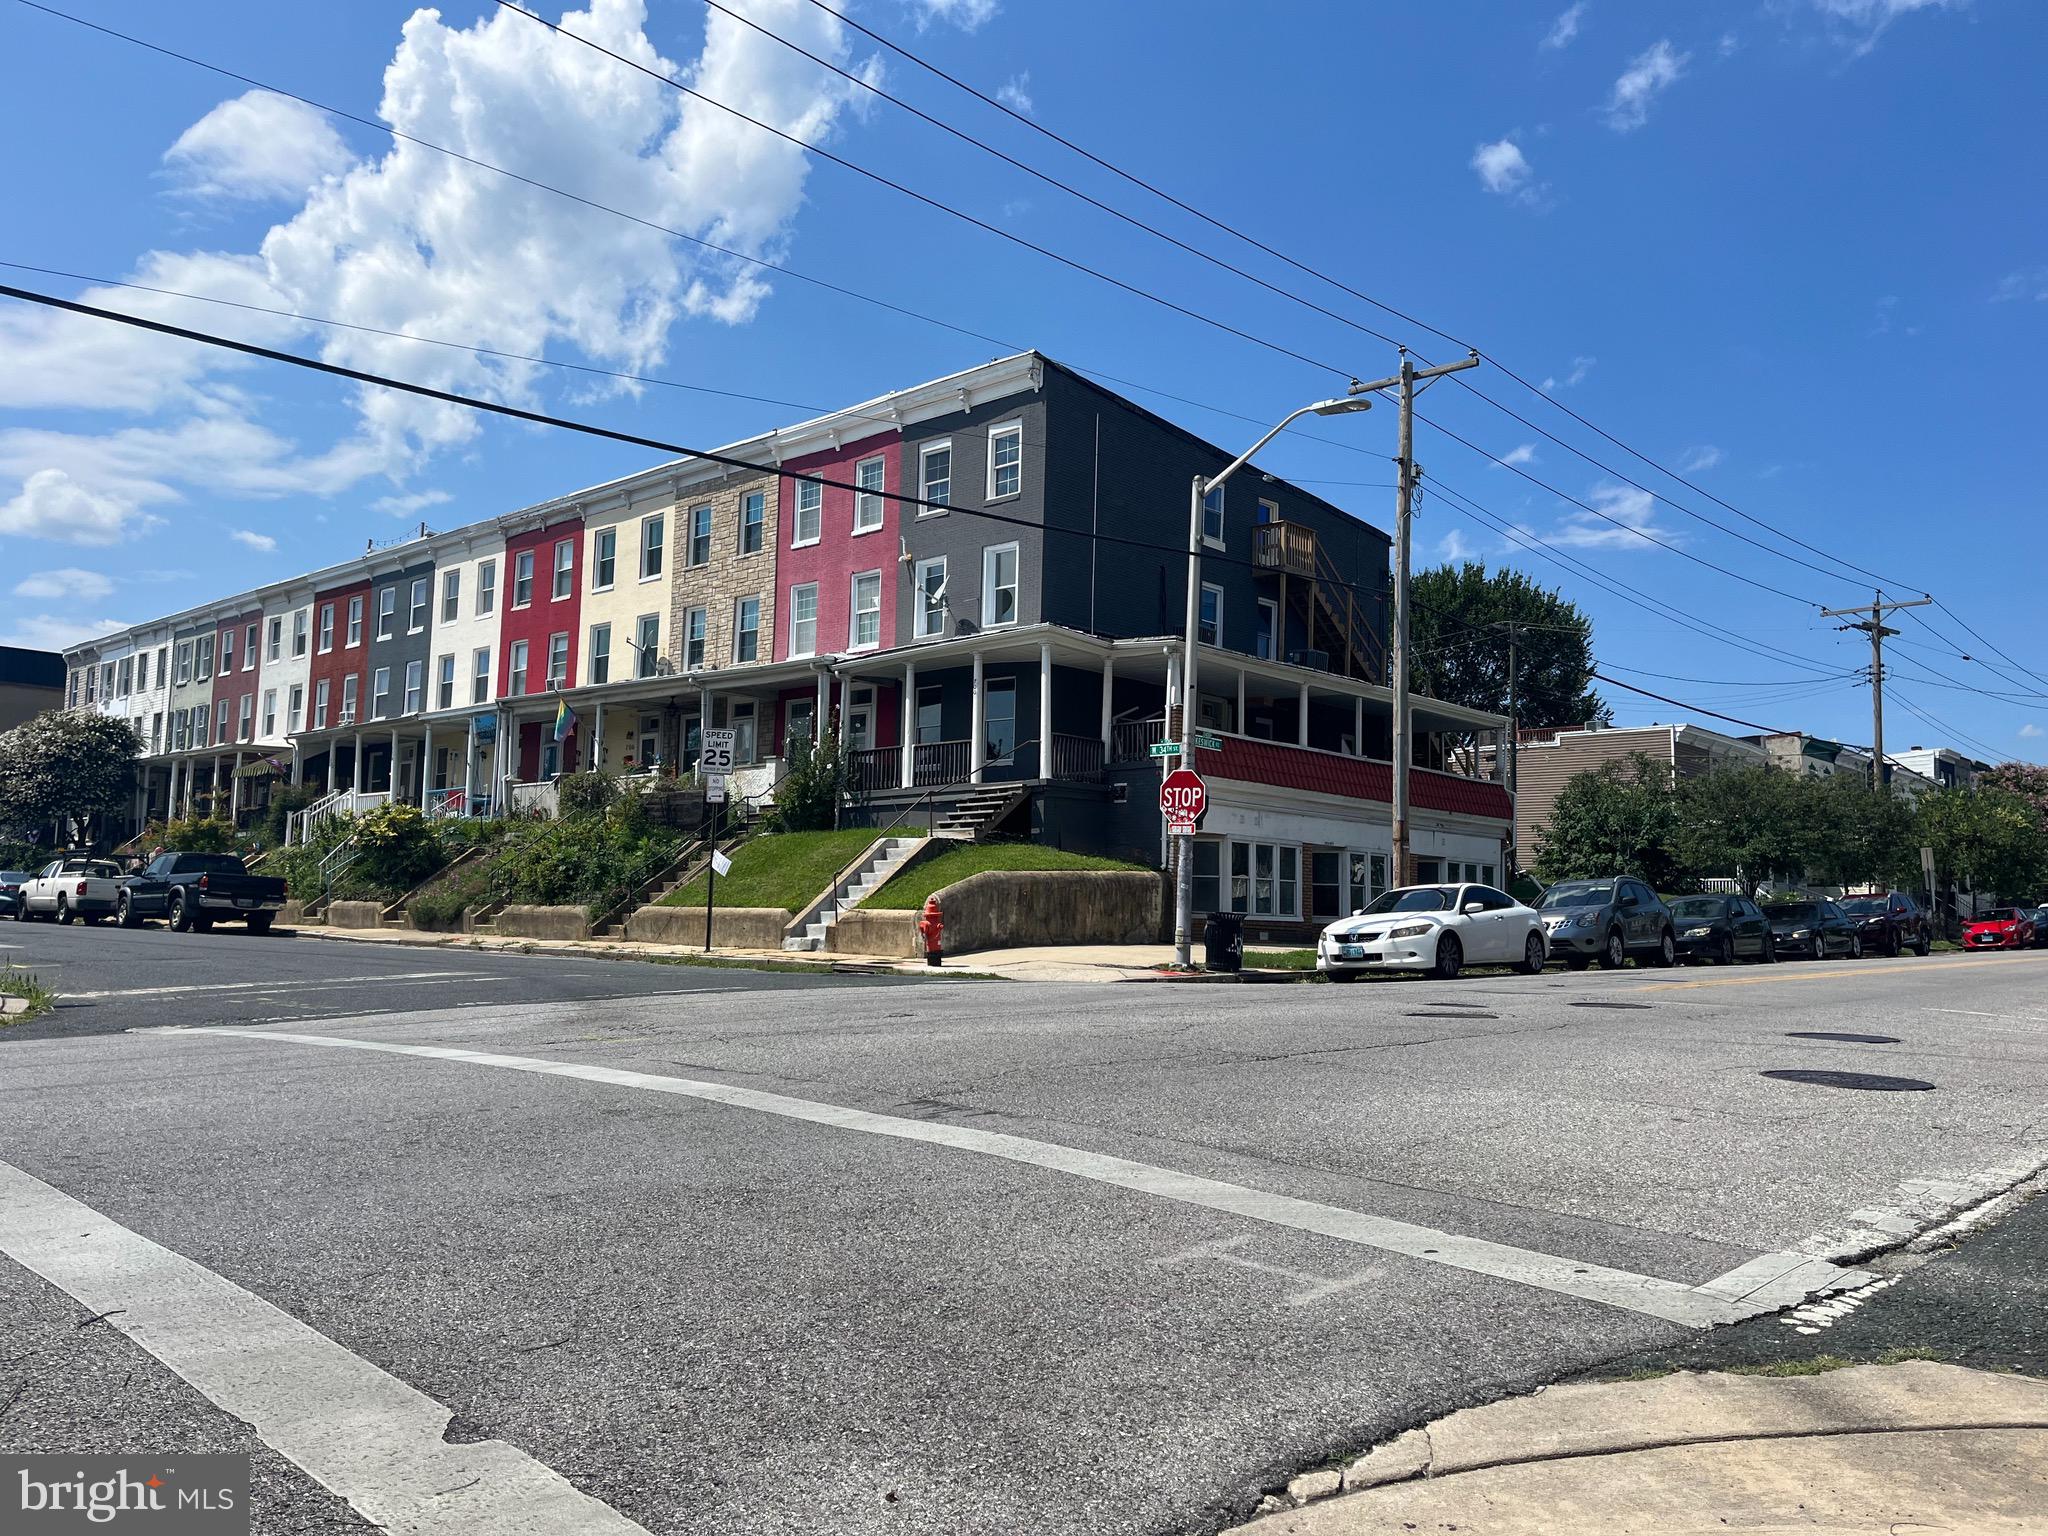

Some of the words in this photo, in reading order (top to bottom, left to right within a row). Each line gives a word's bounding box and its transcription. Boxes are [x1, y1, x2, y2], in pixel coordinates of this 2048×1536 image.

[705, 731, 733, 739] SPEED
[1159, 745, 1173, 754] 34TH
[703, 749, 731, 767] 25
[1163, 787, 1202, 807] STOP
